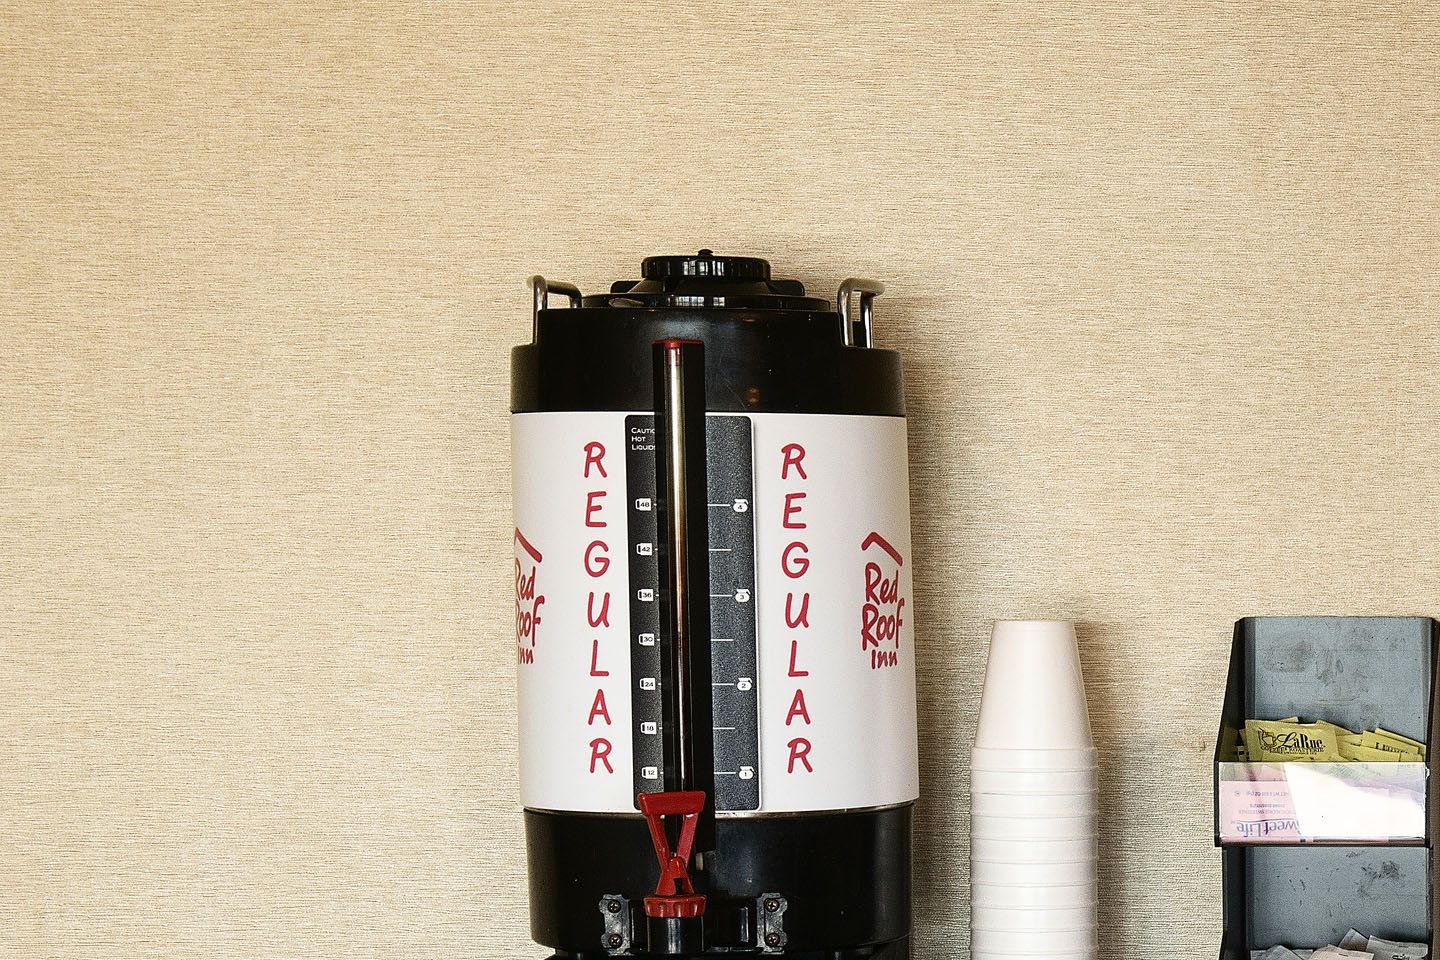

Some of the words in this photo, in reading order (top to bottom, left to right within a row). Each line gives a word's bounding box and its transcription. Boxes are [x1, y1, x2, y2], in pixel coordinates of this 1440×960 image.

[584, 441, 613, 774] REGULAR
[781, 443, 813, 774] REGULAR
[861, 597, 905, 650] Roof
[865, 562, 899, 605] Red
